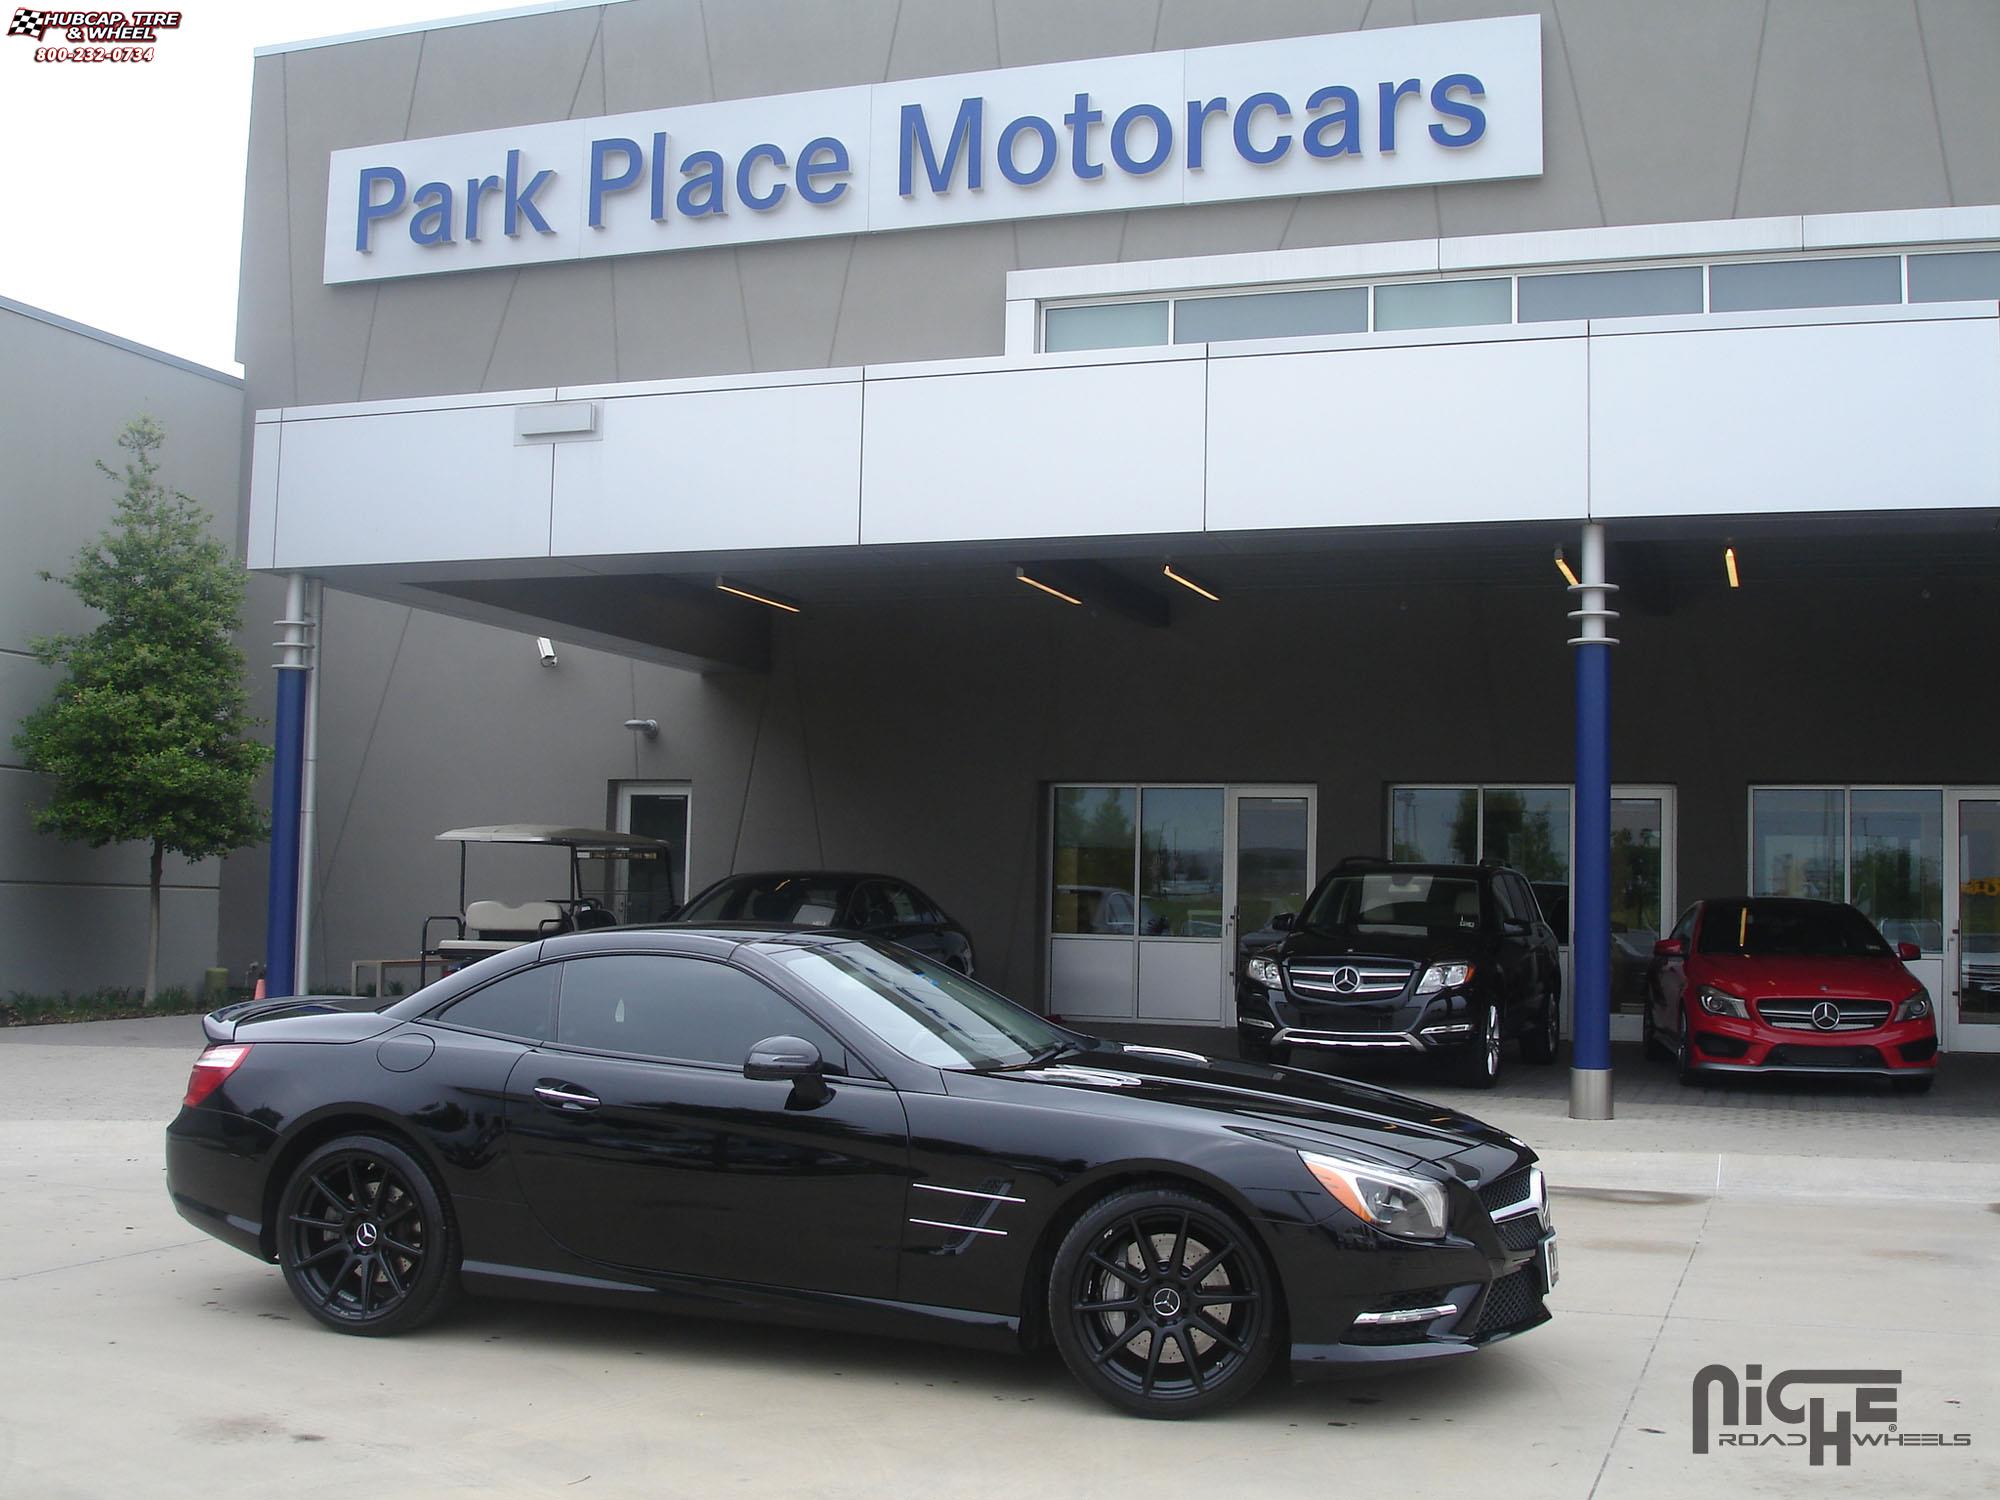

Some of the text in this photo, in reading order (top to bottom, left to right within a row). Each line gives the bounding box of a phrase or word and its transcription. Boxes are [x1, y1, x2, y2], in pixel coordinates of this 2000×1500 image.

[355, 72, 1488, 253] Park Place Motorcars
